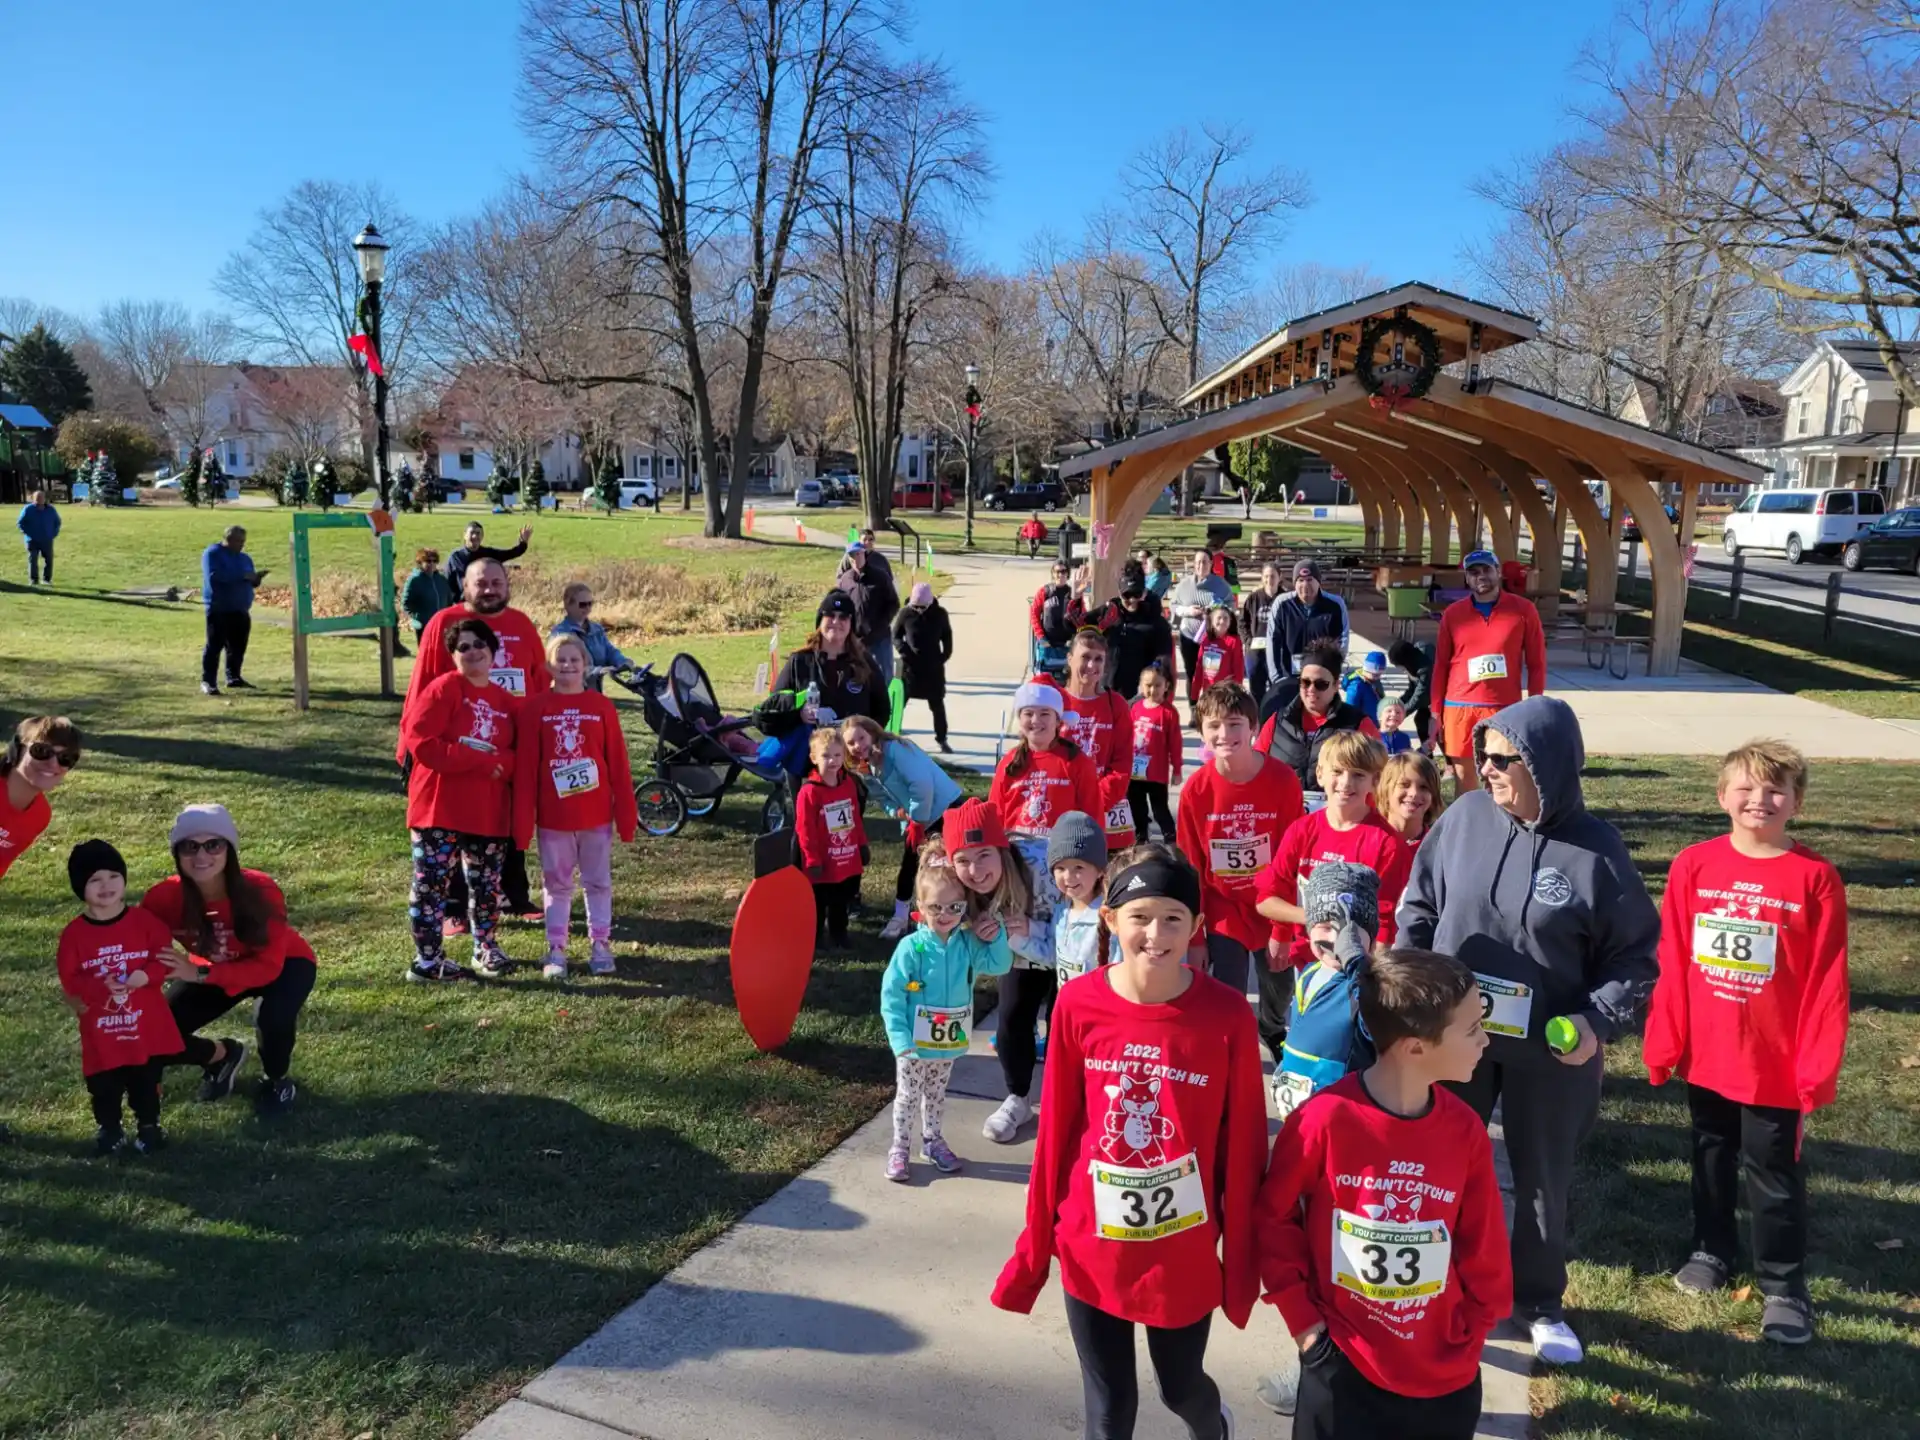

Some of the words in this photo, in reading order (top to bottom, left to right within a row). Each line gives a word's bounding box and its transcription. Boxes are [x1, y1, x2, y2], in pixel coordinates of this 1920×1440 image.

[497, 676, 517, 691] 21
[567, 769, 590, 790] 25
[1233, 803, 1255, 811] 2022
[1244, 812, 1269, 820] CATCH
[837, 810, 848, 825] 4
[1108, 809, 1127, 827] 26
[1227, 849, 1257, 869] 53
[1732, 881, 1764, 893] 2022
[1697, 888, 1715, 898] YOU
[1714, 890, 1747, 903] CAN'T
[1746, 894, 1784, 909] CATCH
[1783, 901, 1802, 913] ME
[1711, 931, 1753, 962] 48
[1700, 963, 1727, 980] FUN
[96, 1013, 124, 1029] FUN
[931, 1019, 963, 1042] 60
[1123, 1042, 1161, 1060] 2022
[1084, 1057, 1102, 1071] OU
[1102, 1059, 1142, 1074] CAN'T
[1143, 1062, 1187, 1083] CATCH
[1187, 1072, 1210, 1088] ME
[1387, 1160, 1426, 1177] 2022
[1110, 1175, 1127, 1186] YOU
[1126, 1178, 1146, 1188] CAN'T
[1146, 1173, 1169, 1187] CATCH
[1168, 1169, 1179, 1180] ME
[1335, 1174, 1363, 1189] YOU
[1364, 1176, 1405, 1192] CAN'T
[1405, 1180, 1442, 1201] CATCH
[1121, 1185, 1179, 1229] 32
[1353, 1225, 1370, 1238] YOU
[1369, 1229, 1394, 1240] CAN'T
[1394, 1231, 1419, 1242] CATCH
[1419, 1233, 1431, 1242] ME
[1361, 1243, 1421, 1287] 33
